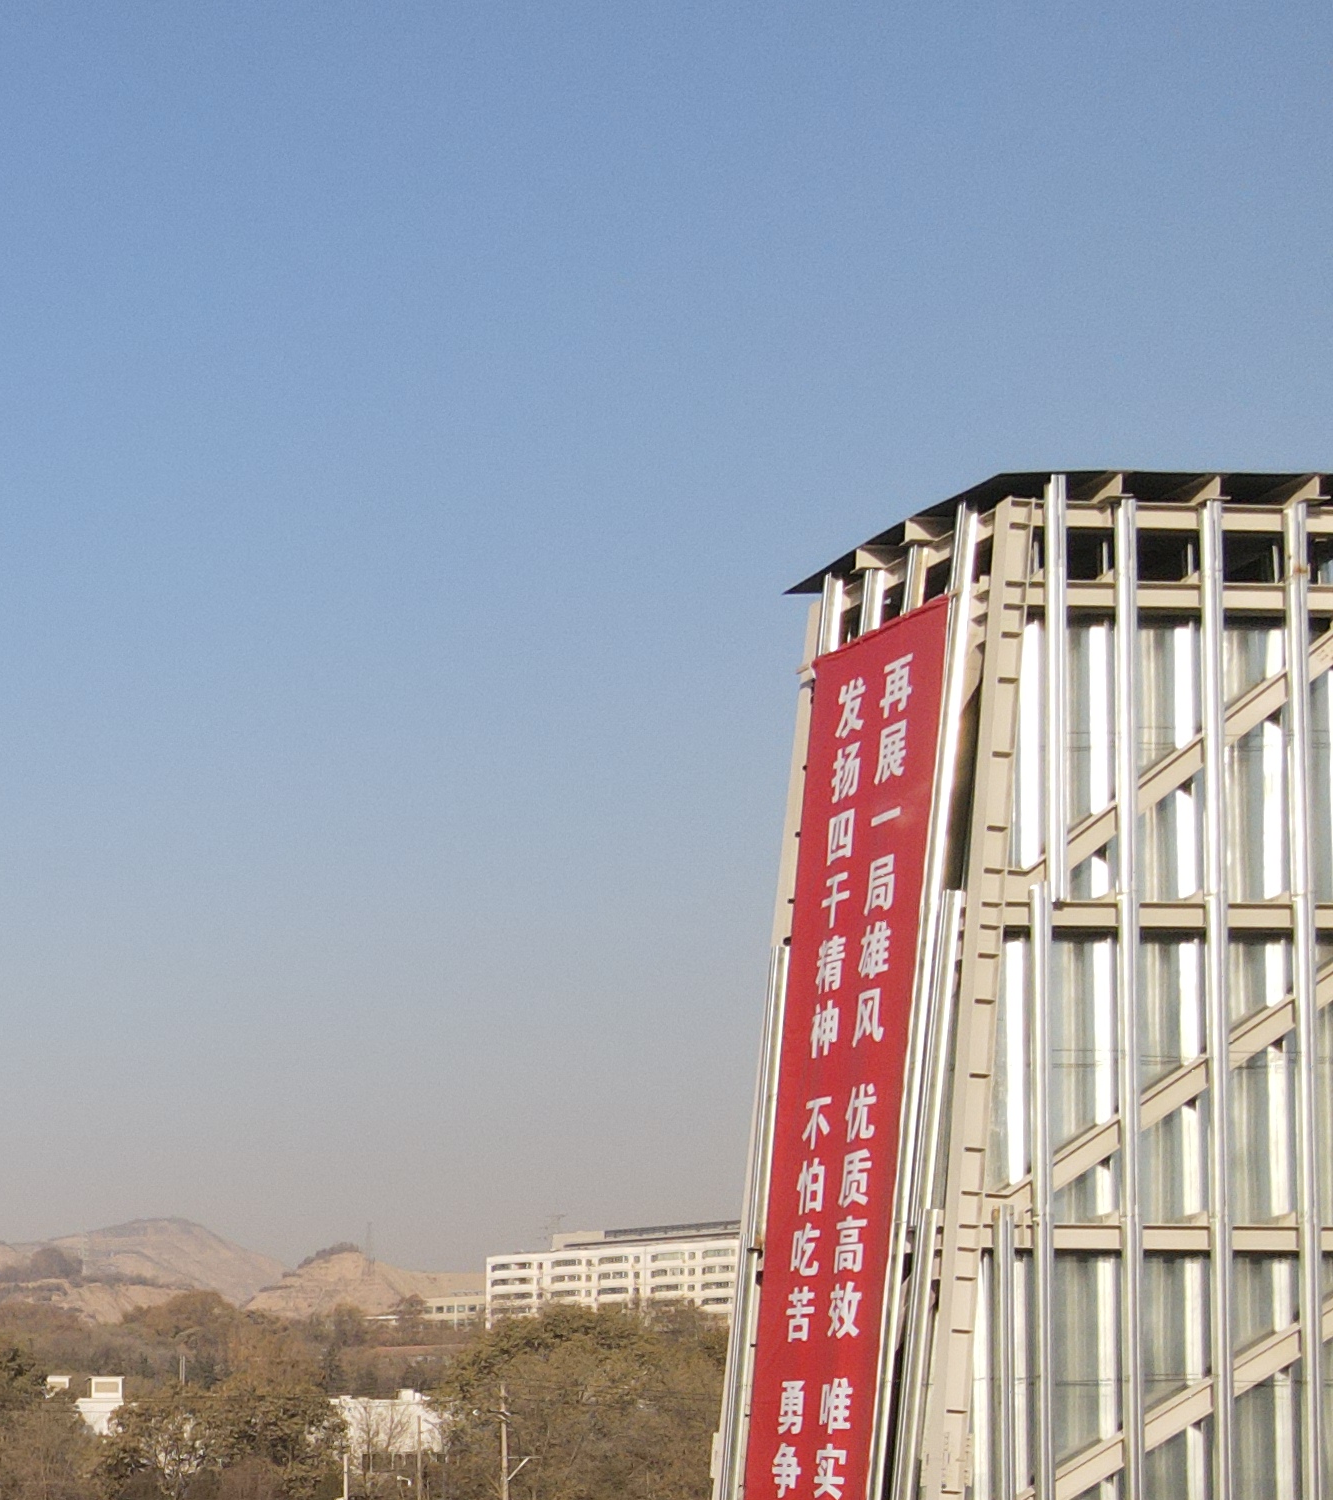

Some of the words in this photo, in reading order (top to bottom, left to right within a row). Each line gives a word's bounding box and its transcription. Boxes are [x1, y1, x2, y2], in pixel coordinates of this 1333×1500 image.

[851, 653, 913, 1048] 再展一局雄风
[786, 1094, 833, 1343] 不怕吃苦
[826, 1082, 877, 1340] 优质高效
